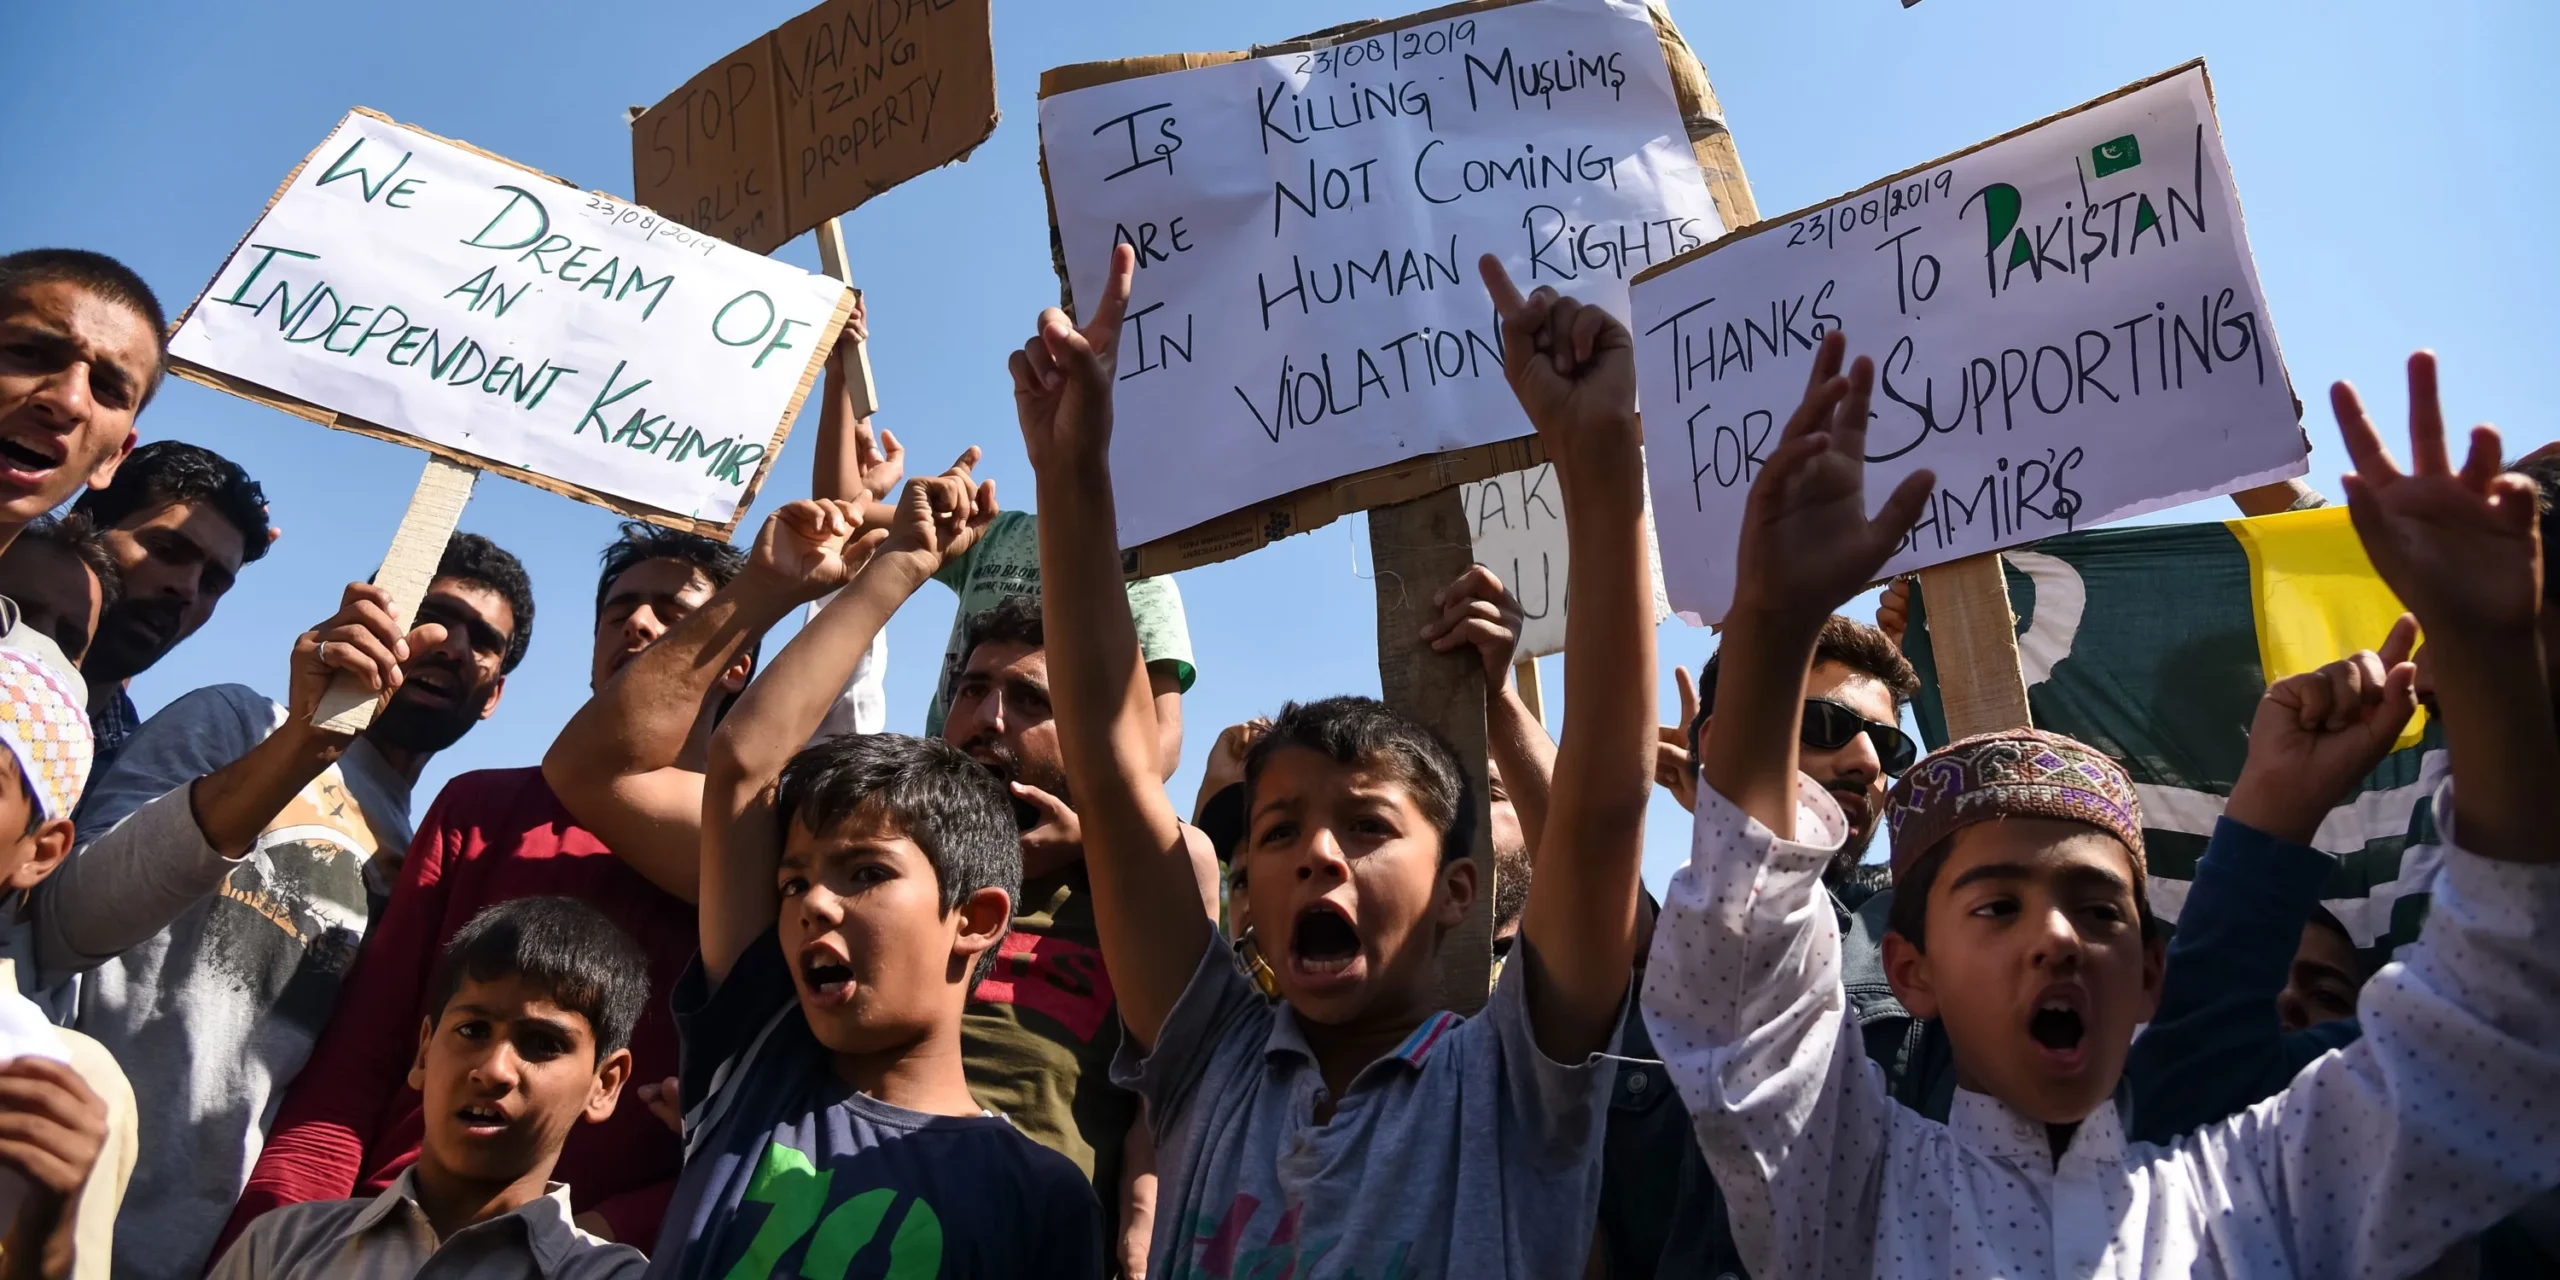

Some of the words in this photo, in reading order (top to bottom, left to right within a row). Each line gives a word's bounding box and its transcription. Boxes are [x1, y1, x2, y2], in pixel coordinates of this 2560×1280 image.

[652, 62, 756, 188] STOP
[777, 0, 960, 98] VAND
[1294, 19, 1477, 78] 23/08/2019
[801, 69, 943, 198] PROPERTY
[1092, 102, 1184, 184] IS
[1255, 79, 1434, 155] KILLING
[1464, 47, 1627, 112] MUSLIMS
[315, 136, 428, 210] WE
[460, 184, 677, 322] DREAM
[712, 289, 812, 370] OF
[586, 197, 717, 257] 23/08/2019
[1110, 216, 1194, 269] ARE
[1273, 157, 1379, 238] NOT
[1414, 139, 1616, 205] COMING
[1645, 279, 1845, 404] THANKS
[1874, 226, 1941, 315] TO
[1958, 123, 2208, 299] PAKISTAN
[1787, 169, 1953, 249] 23/08/2019
[443, 265, 534, 319] AN
[1119, 301, 1193, 382] IN
[1256, 233, 1461, 332] HUMAN
[1522, 204, 1702, 280] RIGHTS
[211, 243, 580, 414] INDEPENDENT
[574, 359, 767, 487] KASHMIR
[1686, 403, 1774, 513] FOR
[1863, 287, 2265, 464] SUPPORTING
[1890, 446, 2085, 558] HMIR'S
